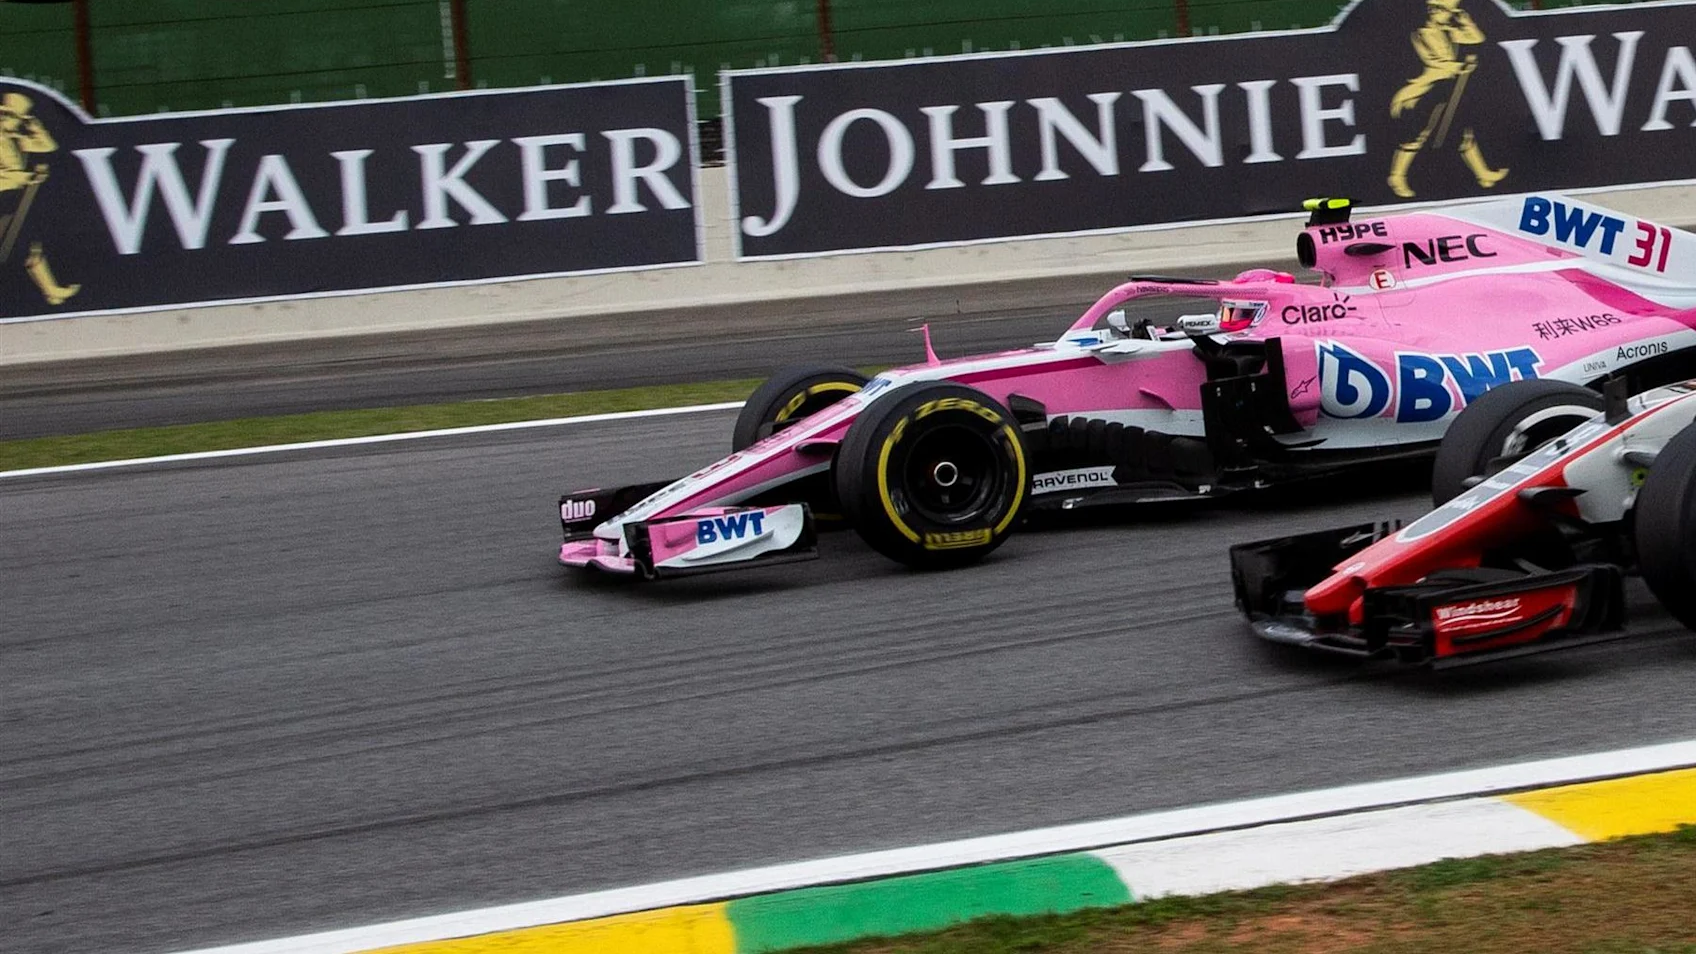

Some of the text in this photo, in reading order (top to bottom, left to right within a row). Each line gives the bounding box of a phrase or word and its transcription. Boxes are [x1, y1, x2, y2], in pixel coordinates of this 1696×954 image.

[742, 73, 1367, 237] JOHNNIE
[70, 127, 693, 255] WALKER
[1320, 221, 1388, 244] HYPE
[1519, 196, 1626, 257] BWT
[1402, 233, 1498, 269] NEC
[1628, 220, 1673, 273] 31
[1374, 271, 1392, 289] E
[1281, 298, 1348, 326] Claro
[1615, 339, 1669, 362] Acronis
[1395, 345, 1543, 423] BWT
[1033, 471, 1108, 489] RAVENOL
[561, 499, 596, 520] duo
[696, 509, 765, 545] BWT
